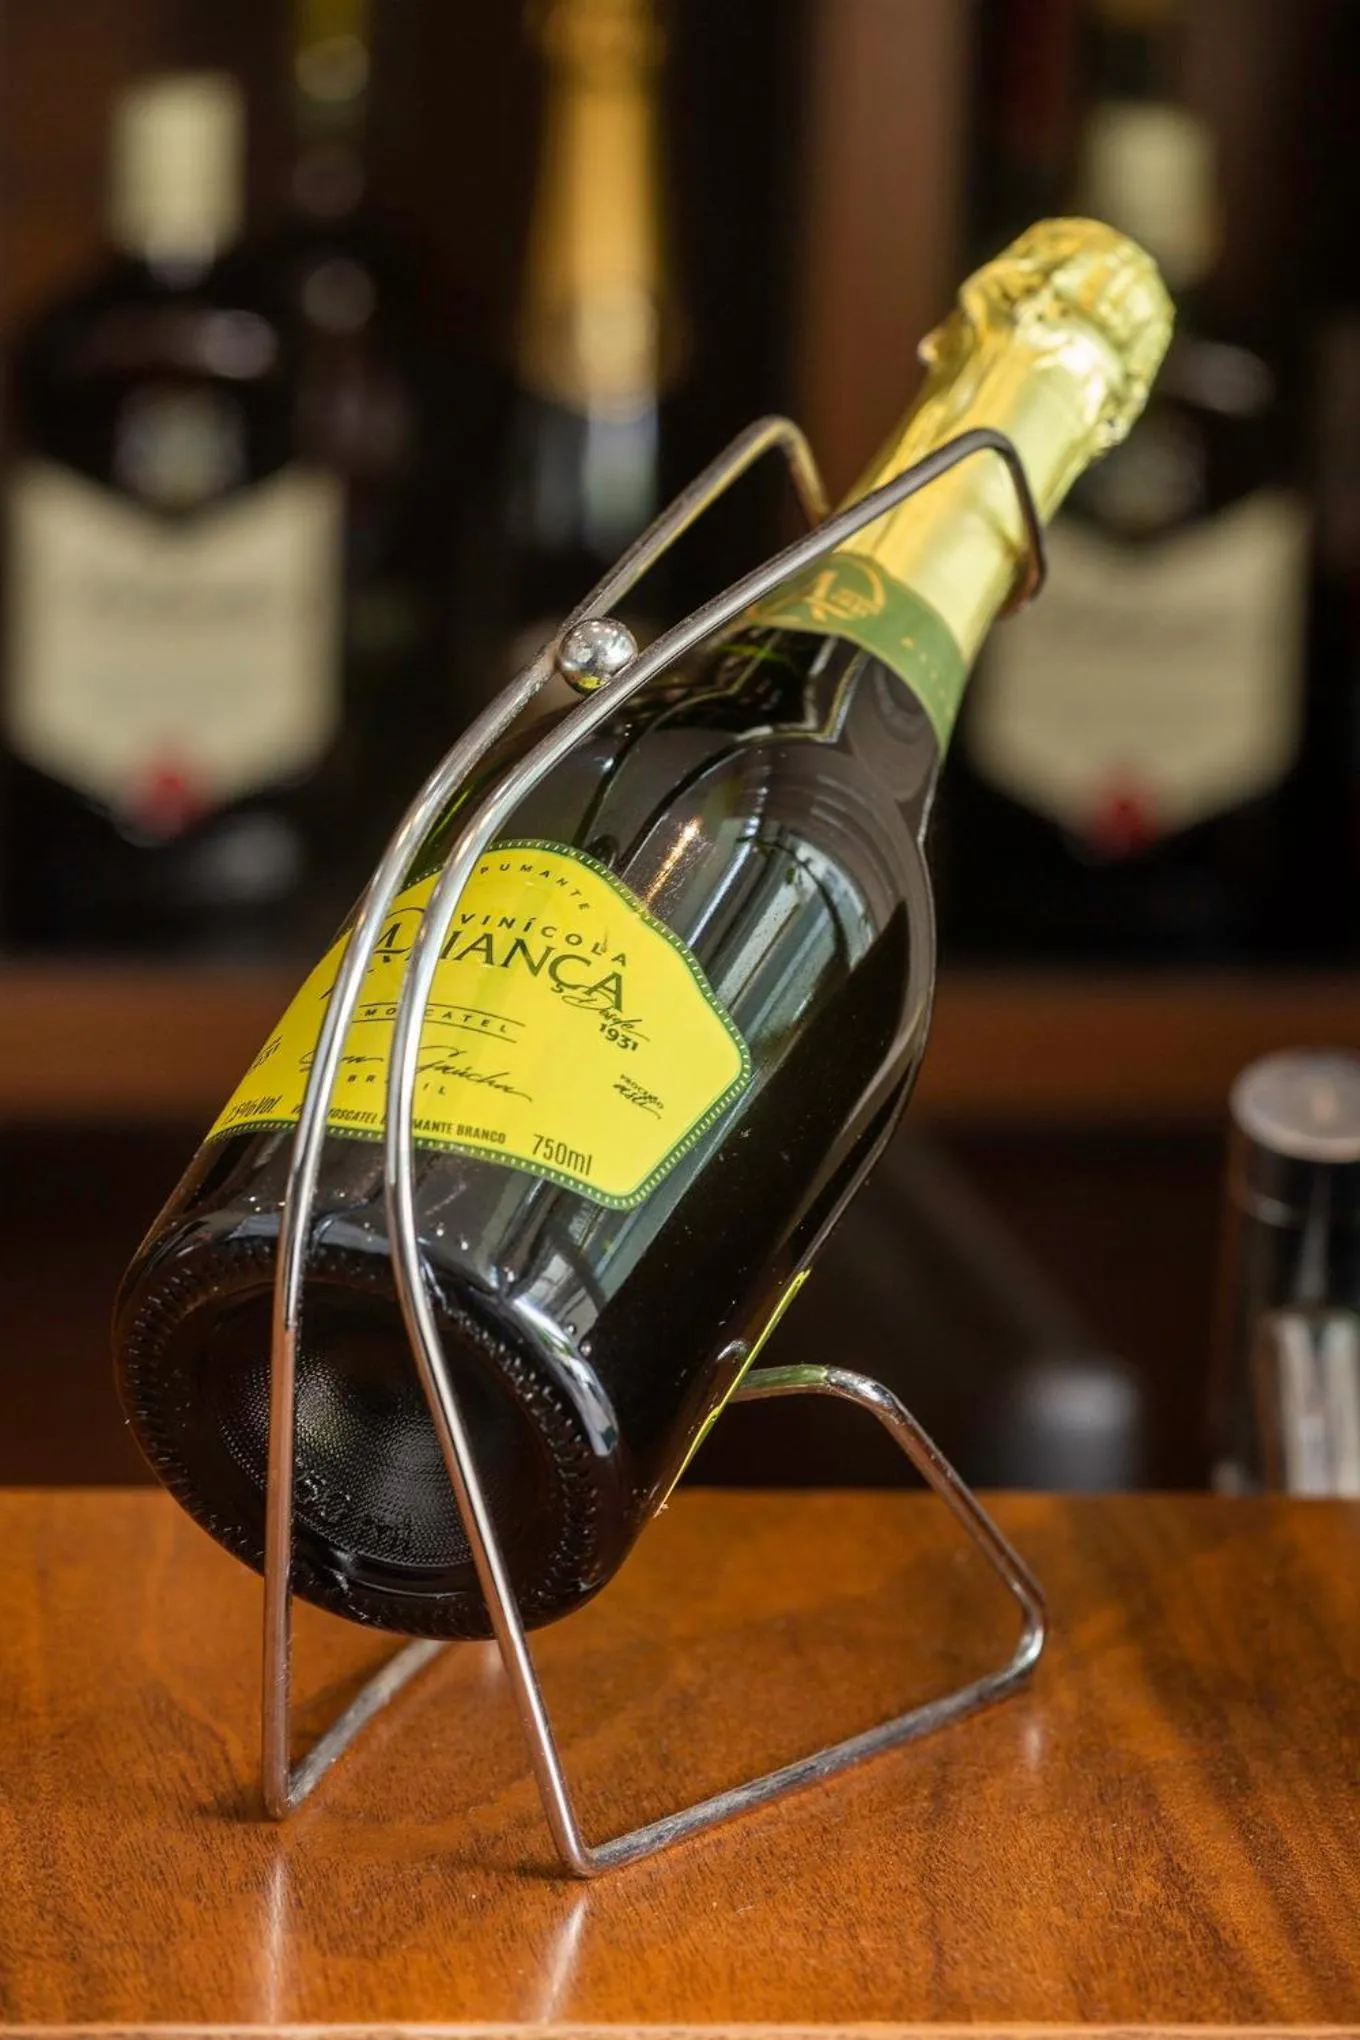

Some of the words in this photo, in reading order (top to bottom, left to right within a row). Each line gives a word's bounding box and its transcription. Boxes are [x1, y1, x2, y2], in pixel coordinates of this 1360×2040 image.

[480, 863, 591, 911] PUMANTE
[461, 913, 626, 967] VINÍCOLA
[364, 1008, 507, 1033] MOCATEL
[599, 1022, 639, 1051] 1931
[347, 1073, 447, 1096] BRIL
[456, 1123, 506, 1145] BRANCO
[532, 1134, 593, 1176] 750ml
